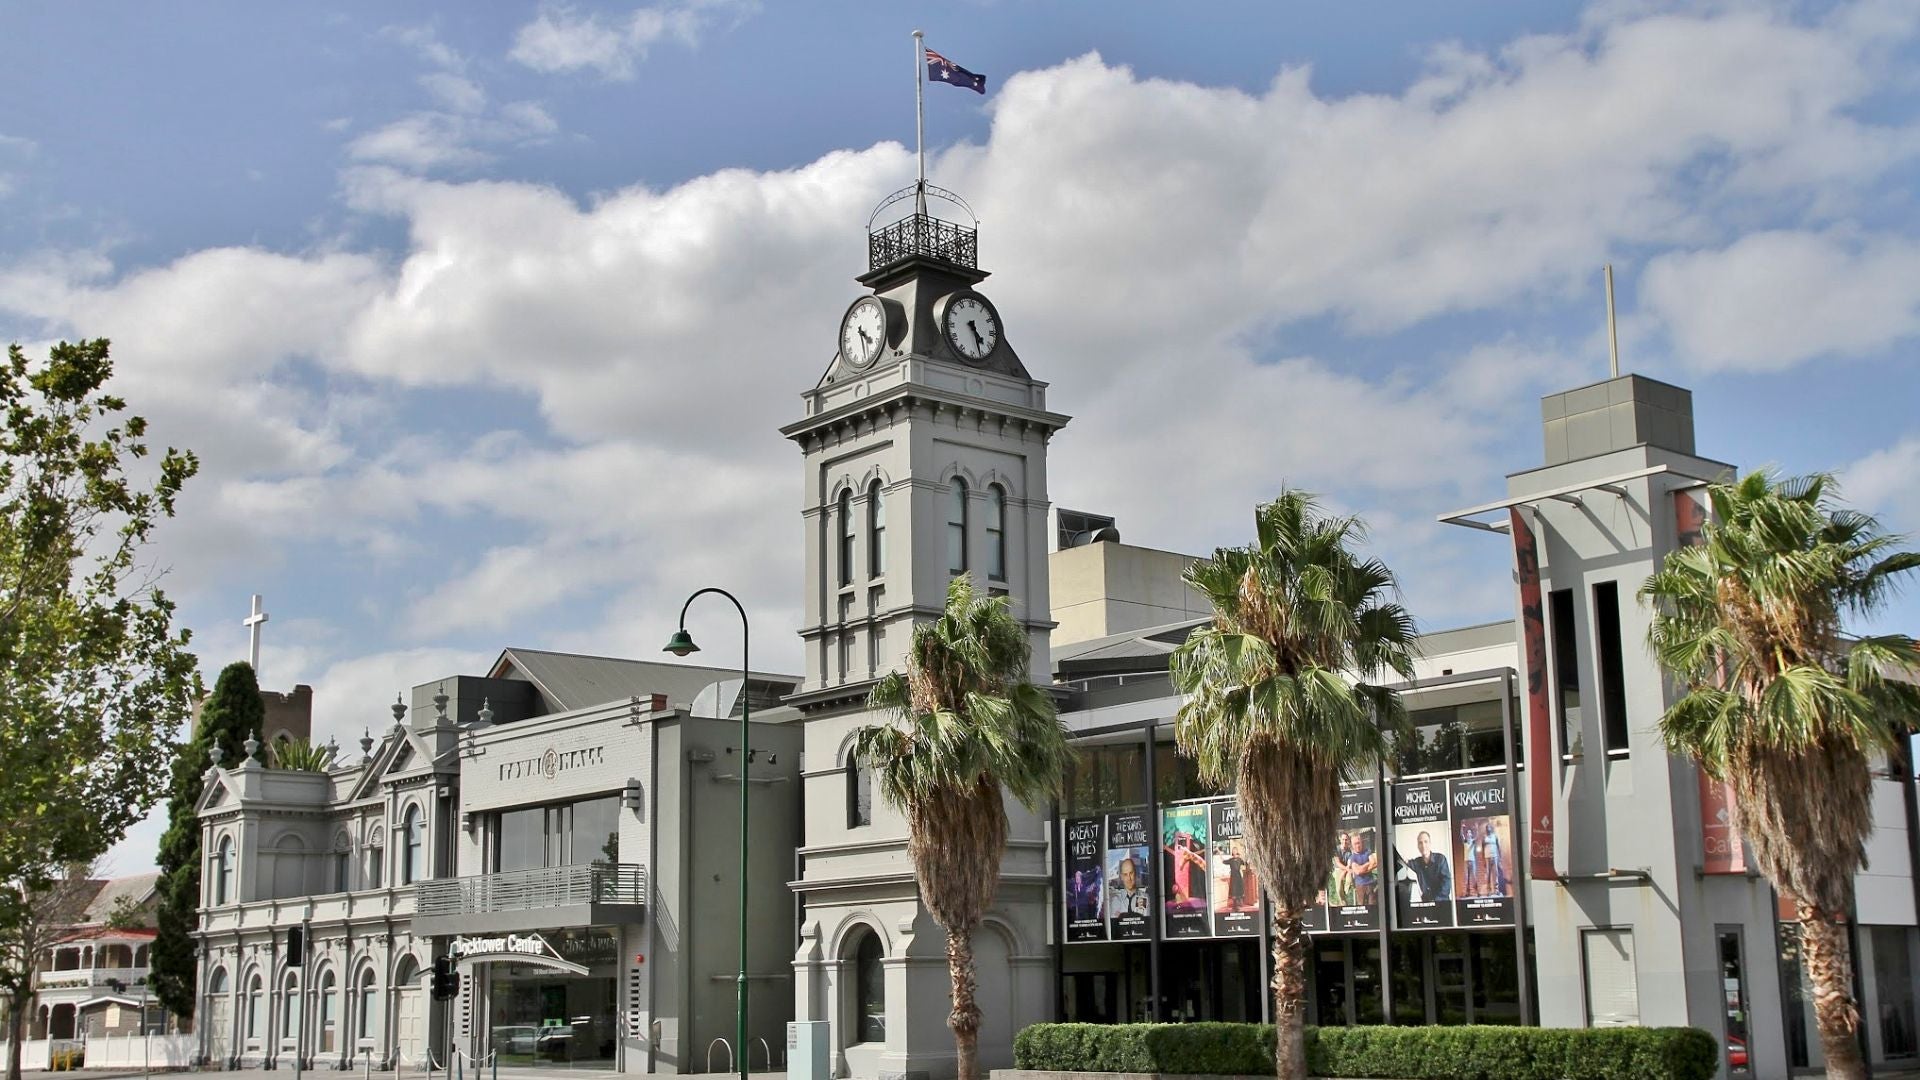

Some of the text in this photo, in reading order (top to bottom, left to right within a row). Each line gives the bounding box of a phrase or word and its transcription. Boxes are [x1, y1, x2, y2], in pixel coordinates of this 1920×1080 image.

[499, 746, 604, 781] TOWN HALL
[1405, 790, 1432, 803] MICHAEL
[1354, 802, 1363, 814] OF
[1364, 801, 1374, 813] US
[1394, 802, 1444, 817] KIERAN HARVEY
[1069, 824, 1099, 840] BREAST
[1071, 840, 1097, 856] WISHES
[507, 934, 544, 954] Centre
